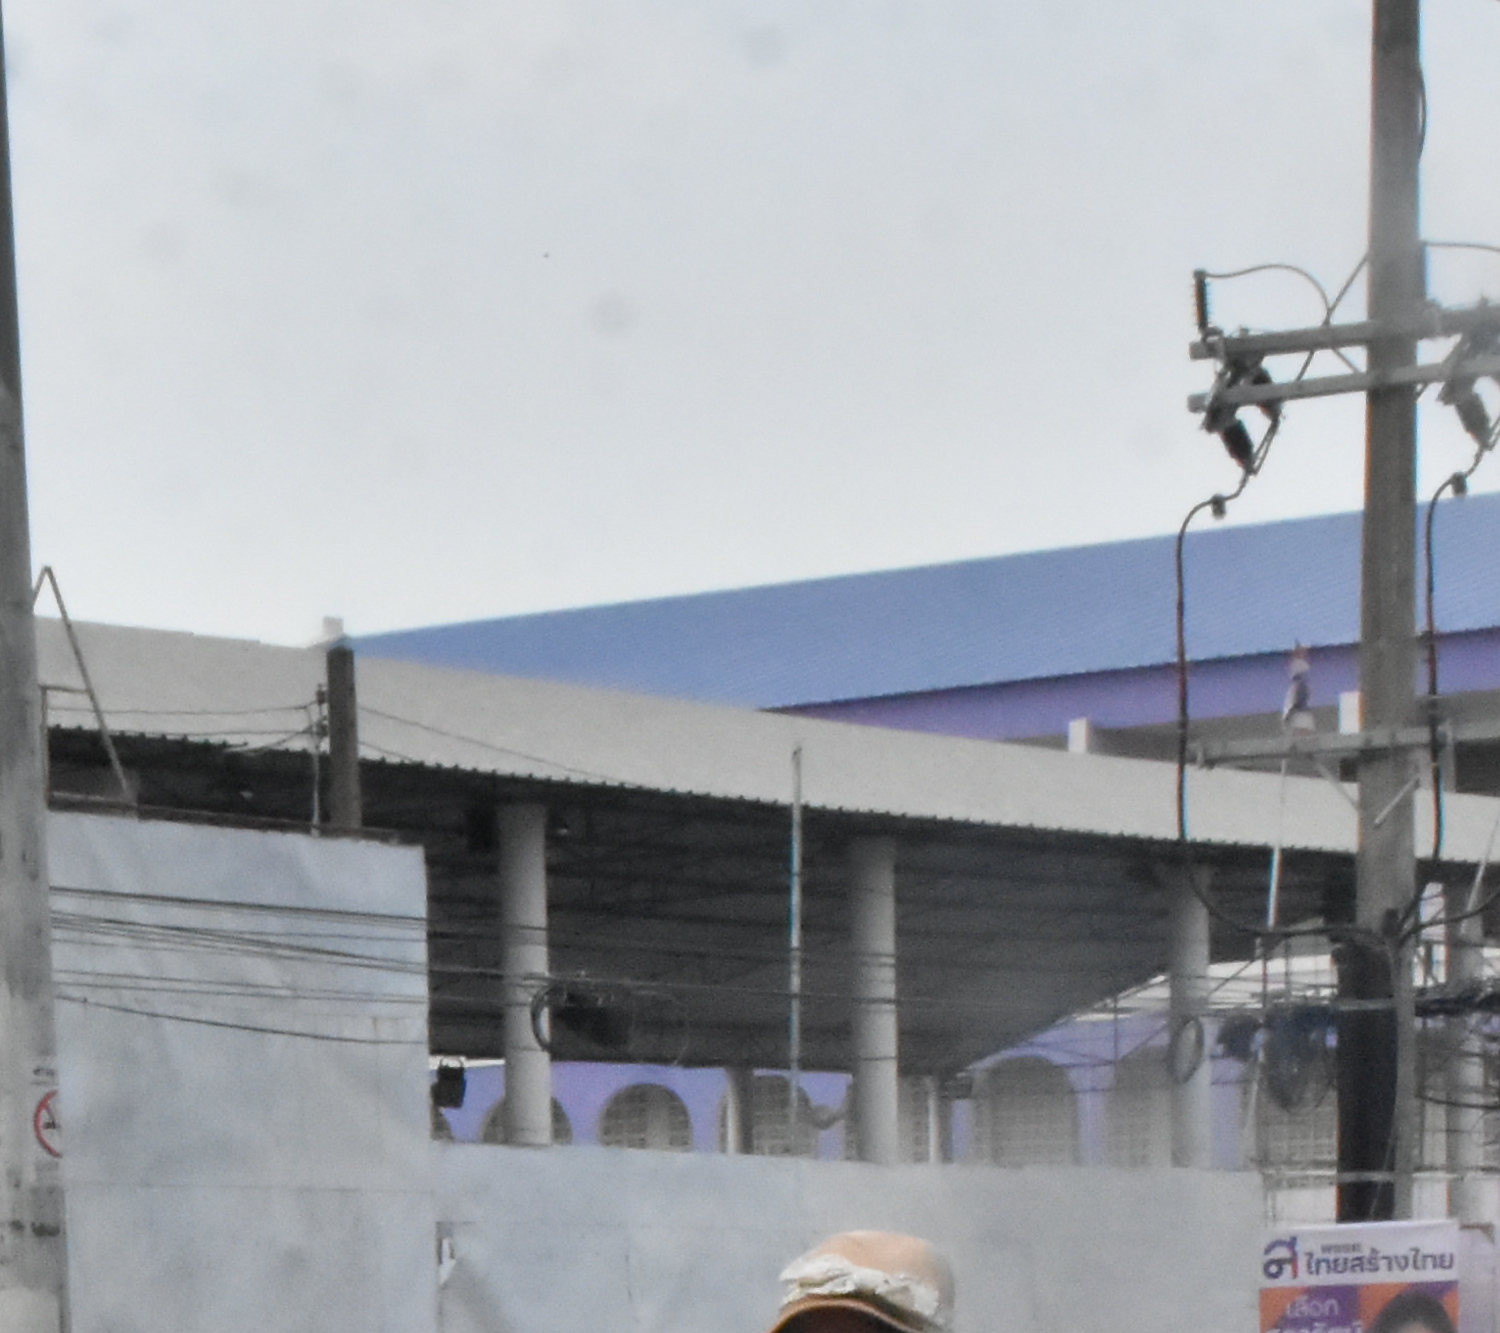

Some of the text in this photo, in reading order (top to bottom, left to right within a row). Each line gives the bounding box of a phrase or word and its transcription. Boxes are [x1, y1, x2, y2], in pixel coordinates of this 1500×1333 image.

[1303, 1247, 1454, 1276] ไทยสร้างไทย
